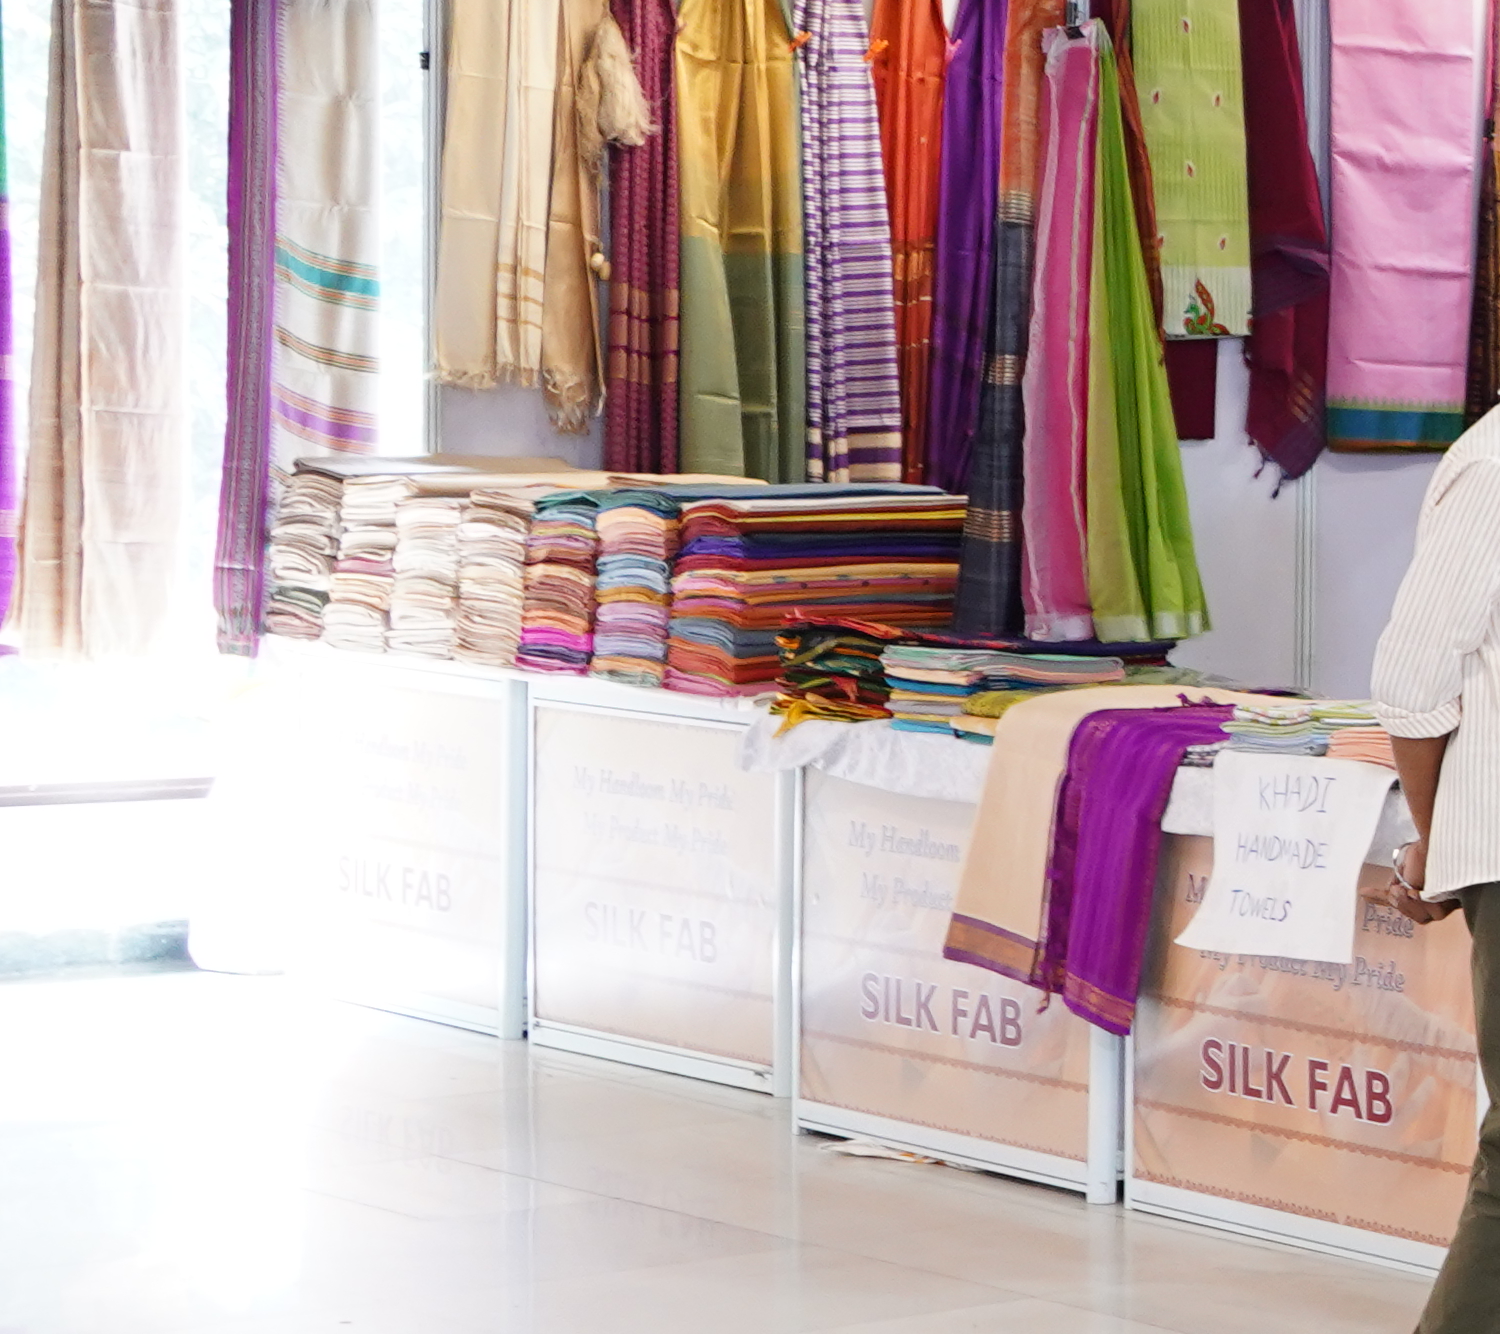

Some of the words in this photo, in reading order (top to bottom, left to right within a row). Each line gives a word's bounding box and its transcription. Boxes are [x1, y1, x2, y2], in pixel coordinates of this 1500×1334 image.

[1258, 774, 1336, 813] KHADI
[848, 819, 876, 858] My
[1236, 832, 1330, 870] HANDMADE
[338, 854, 393, 903] SILK
[402, 866, 452, 914] FAB
[1231, 889, 1291, 923] TOWELS
[584, 900, 649, 953] SILK
[658, 912, 719, 965] FAB
[1351, 955, 1406, 993] Pride
[861, 971, 940, 1034] SILK
[952, 988, 1023, 1048] FAB
[1200, 1037, 1296, 1107] SILK
[1307, 1057, 1395, 1127] FAB
